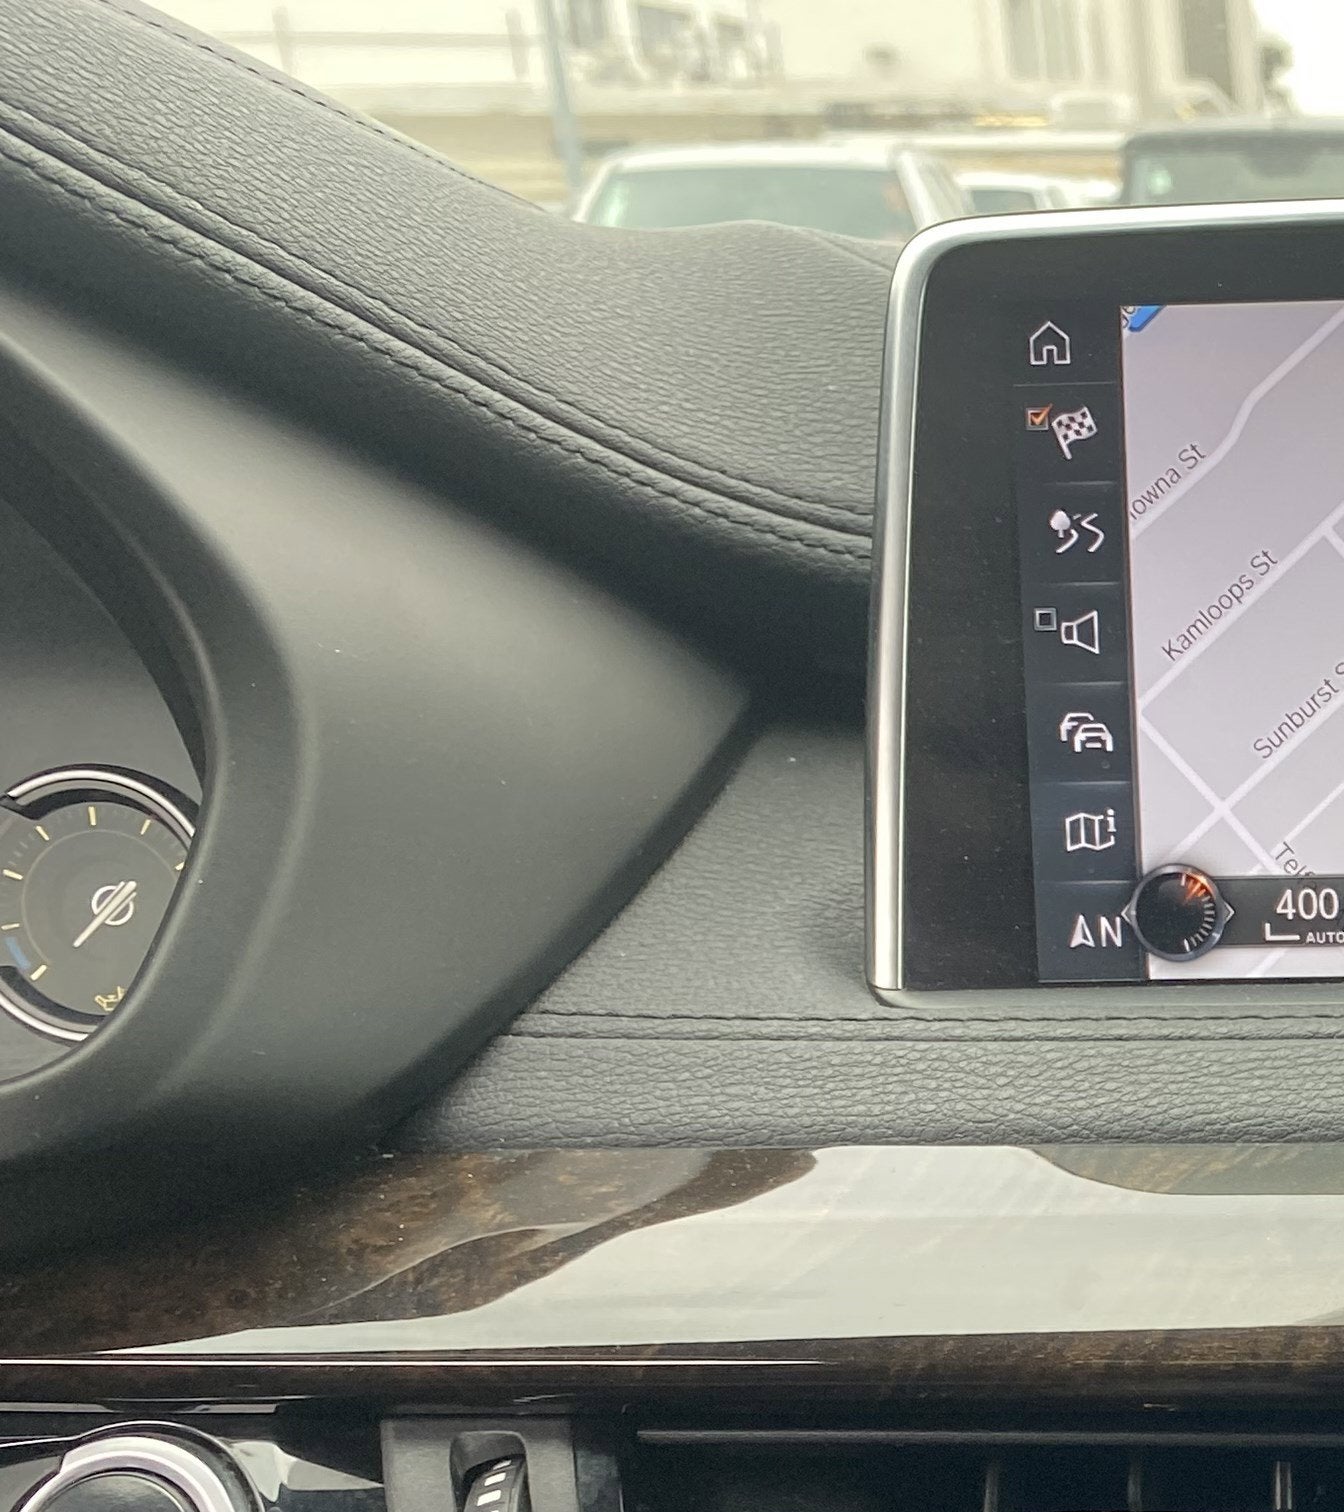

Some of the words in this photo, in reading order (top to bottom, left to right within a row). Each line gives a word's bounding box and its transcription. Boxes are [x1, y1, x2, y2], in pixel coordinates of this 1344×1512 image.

[1179, 442, 1207, 468] St
[1162, 572, 1257, 661] Kamloops
[1249, 548, 1279, 577] St
[1254, 673, 1340, 760] Sunburst
[1275, 889, 1339, 920] 400
[1102, 915, 1121, 948] N
